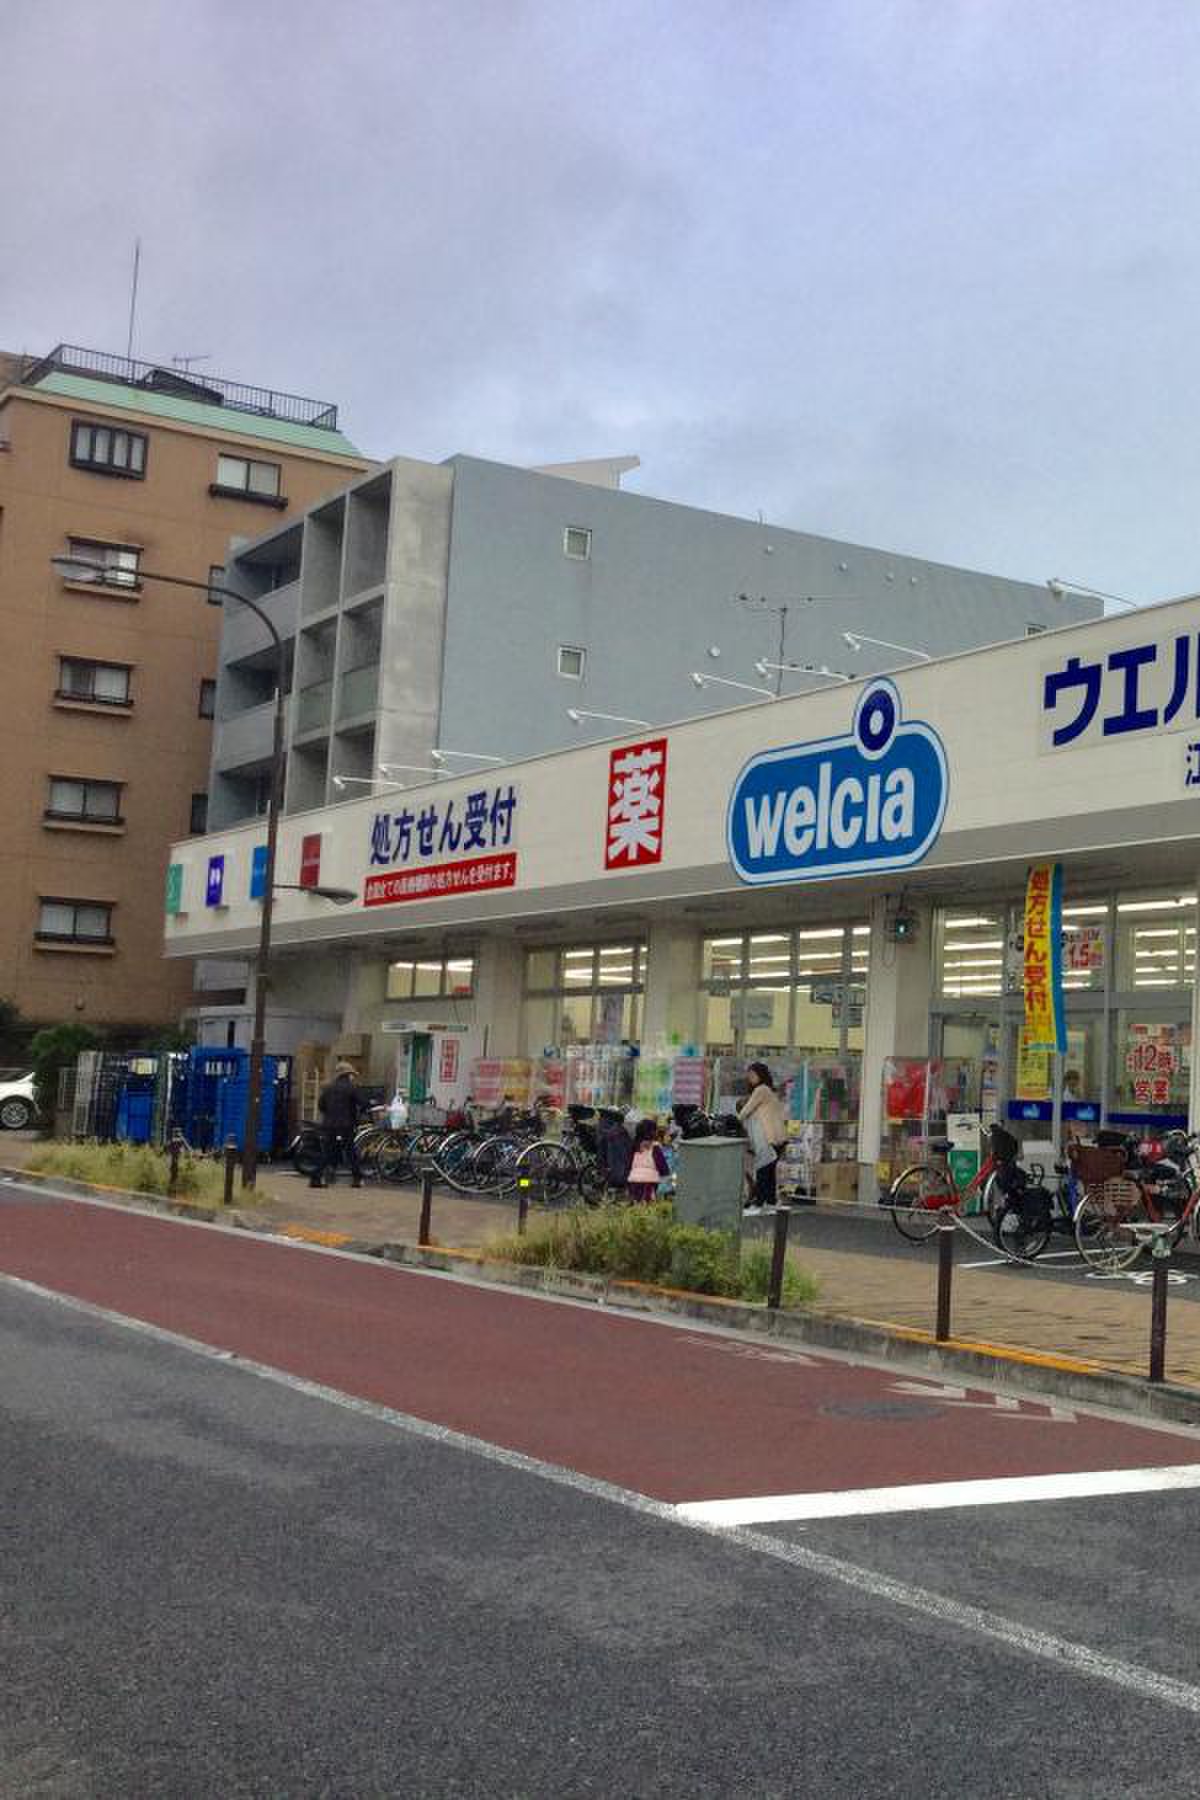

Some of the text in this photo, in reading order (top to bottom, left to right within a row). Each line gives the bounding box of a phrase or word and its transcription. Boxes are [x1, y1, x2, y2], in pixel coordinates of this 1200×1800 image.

[370, 785, 517, 865] 処方せん受付
[608, 750, 665, 862] 薬
[743, 758, 915, 860] welcia
